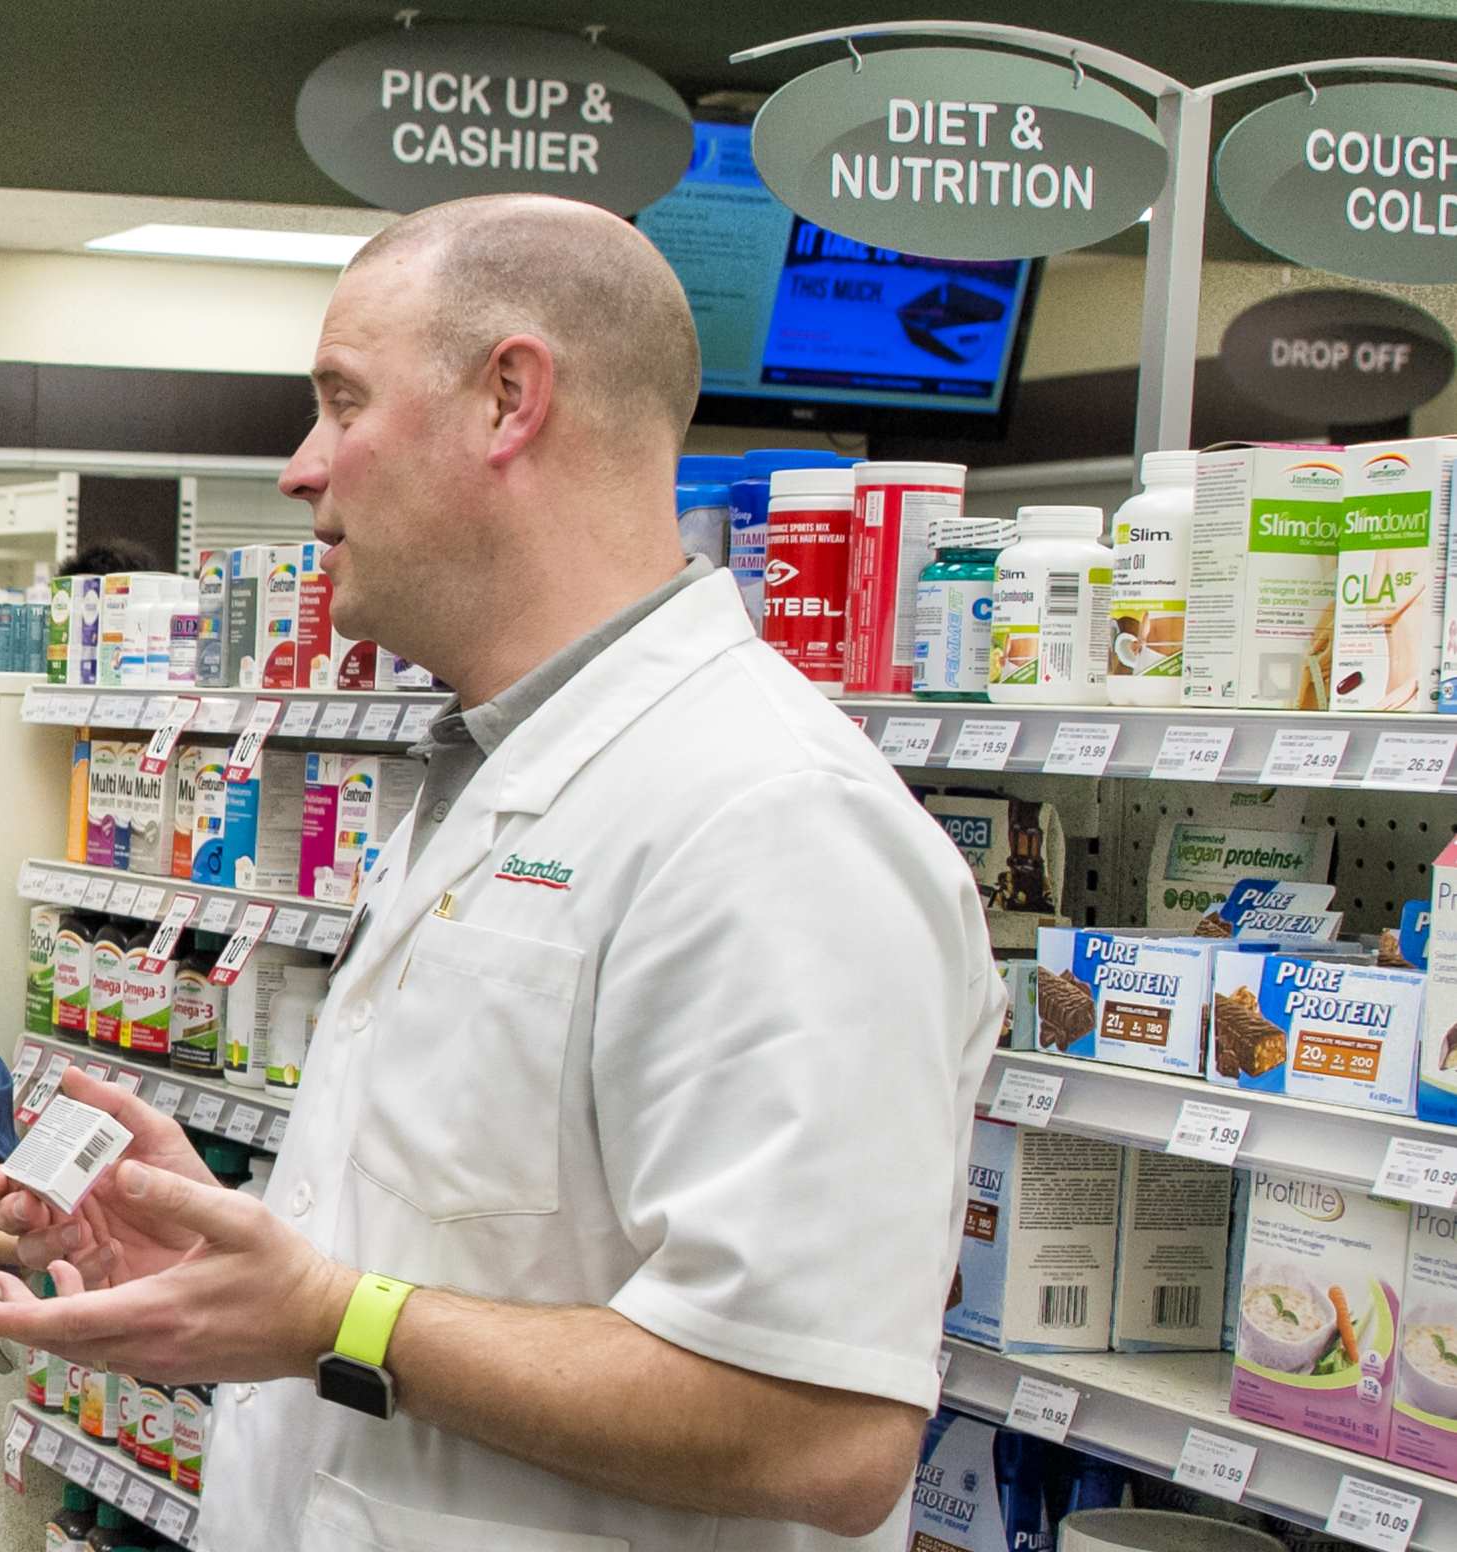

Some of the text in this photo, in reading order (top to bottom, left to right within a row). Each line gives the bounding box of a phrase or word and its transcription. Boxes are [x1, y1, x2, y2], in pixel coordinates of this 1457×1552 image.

[381, 68, 614, 125] PICK UP &
[887, 98, 1044, 154] DIET &
[392, 122, 600, 175] CASHIER
[830, 153, 1095, 211] NUTRITION
[1345, 187, 1457, 238] COLD
[792, 274, 827, 299] THIS
[1270, 338, 1412, 374] DROP OFF
[1344, 507, 1426, 535] Slimdown
[764, 596, 844, 617] STEEL
[905, 738, 930, 751] 14.29
[982, 741, 1008, 754] 19.59
[1078, 745, 1107, 758] 19.99
[1189, 749, 1219, 763] 14.69
[1302, 753, 1338, 768] 24.99
[1407, 757, 1444, 773] 26.29
[134, 777, 162, 799] Multi
[342, 787, 372, 804] Centrum
[1178, 845, 1305, 870] vegan proteins+
[1238, 888, 1296, 910] PURE
[1236, 910, 1325, 935] PROTEIN
[1085, 937, 1139, 966] PURE
[1093, 965, 1180, 997] PROTEIN
[1275, 961, 1345, 993] PURE
[1284, 991, 1392, 1029] PROTEIN
[1349, 1055, 1374, 1069] 200
[1026, 1091, 1053, 1111] 1.99
[1209, 1126, 1239, 1146] 1.99
[968, 1164, 1004, 1191] TEIN
[1423, 1167, 1457, 1186] 10.99
[68, 1365, 80, 1389] C
[119, 1395, 129, 1420] C
[1041, 1405, 1070, 1427] 10.92
[141, 1414, 157, 1439] C
[914, 1462, 944, 1487] URE
[1211, 1461, 1243, 1484] 10.99
[913, 1484, 976, 1523] ROTEIN
[1374, 1511, 1410, 1533] 10.09
